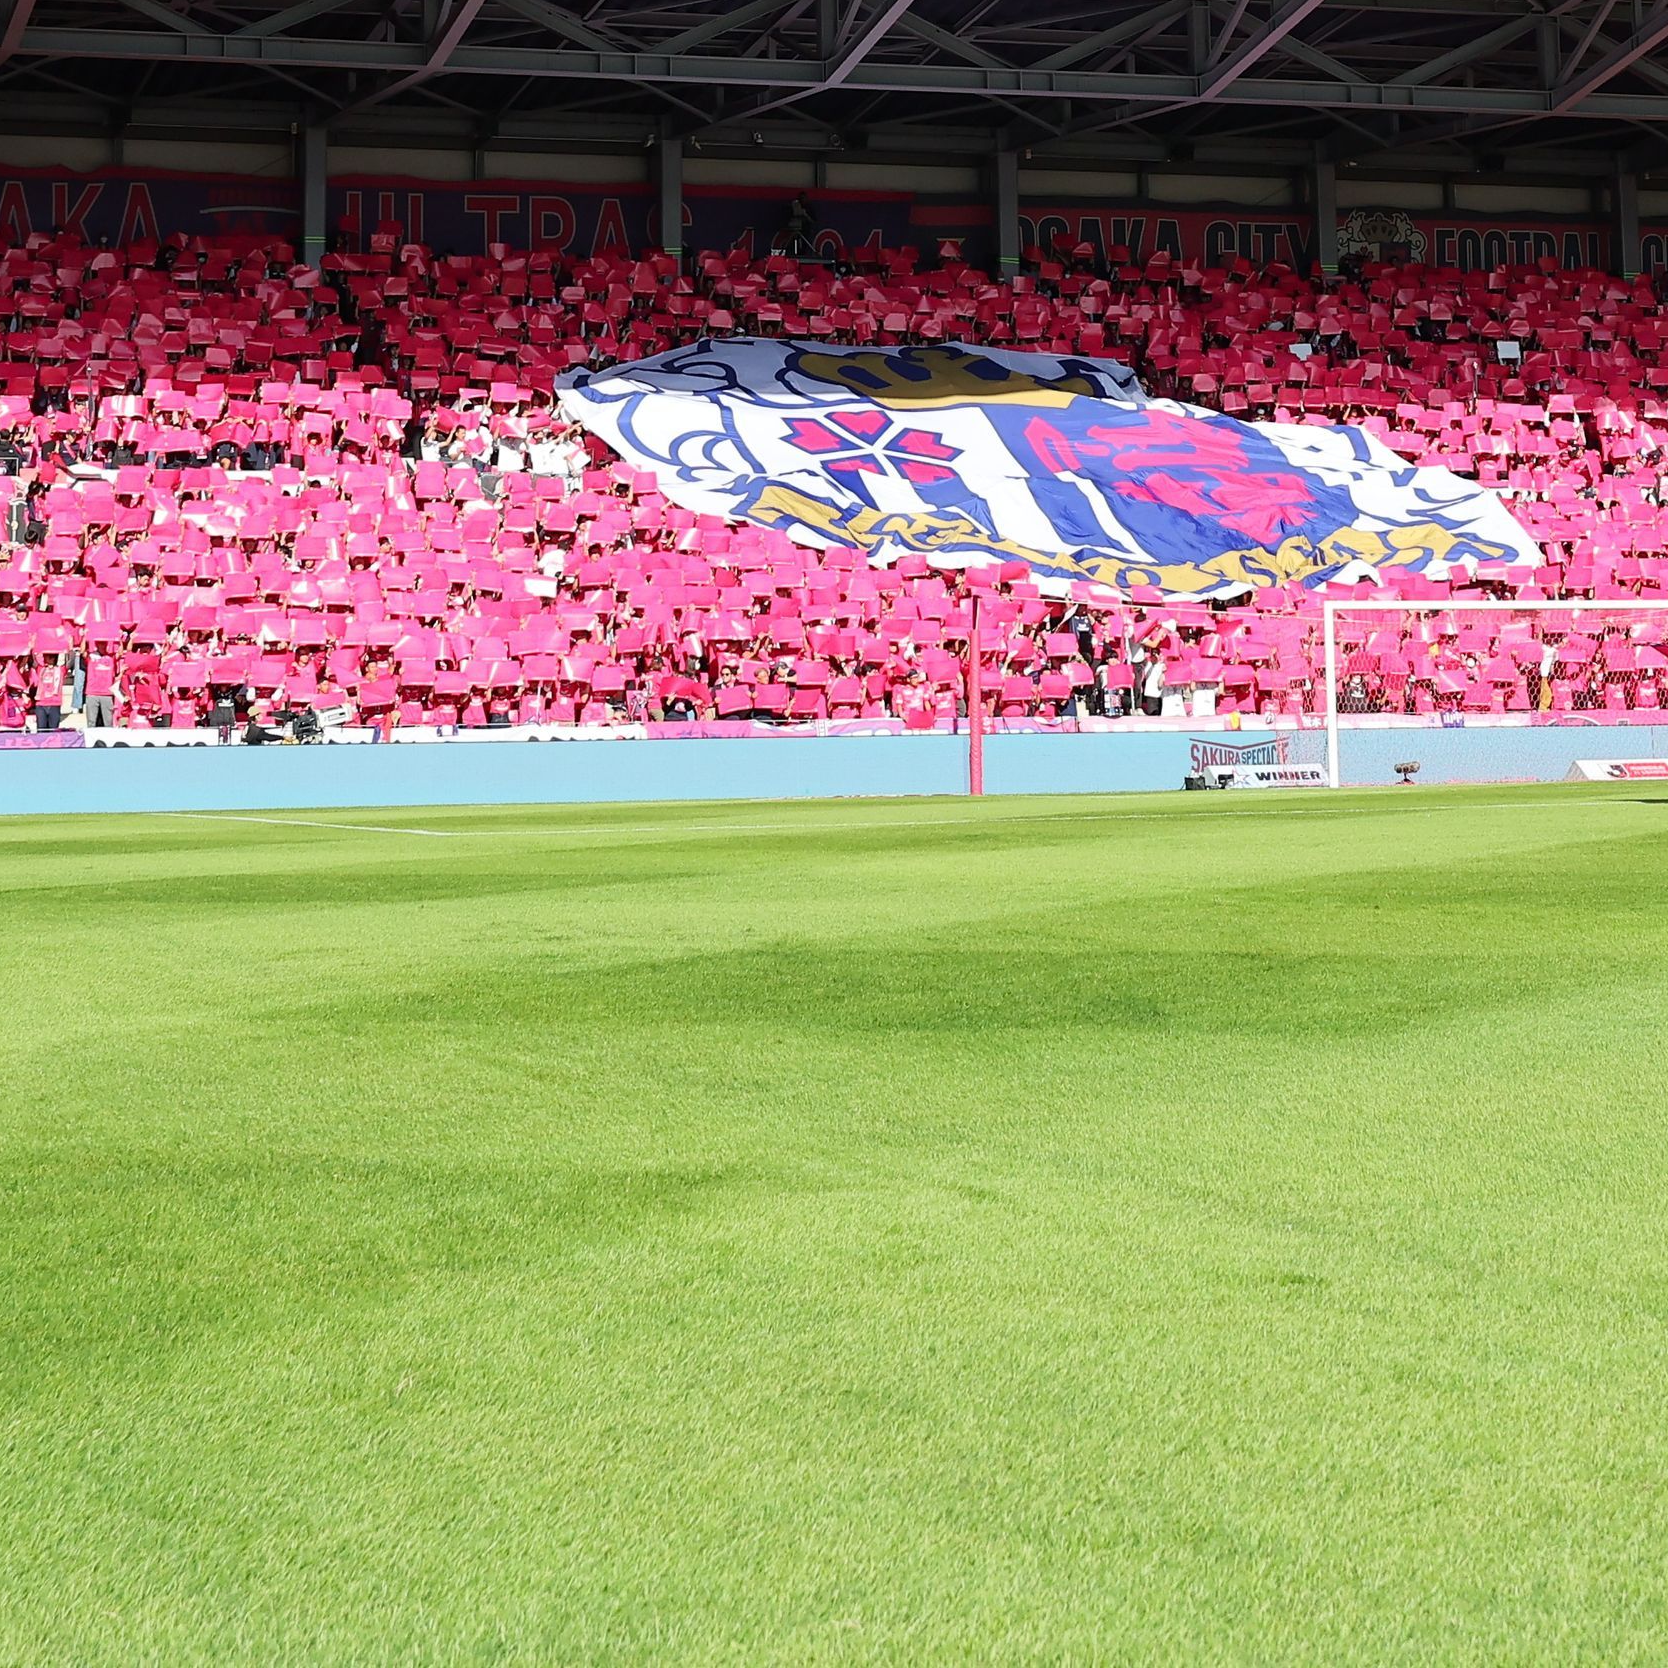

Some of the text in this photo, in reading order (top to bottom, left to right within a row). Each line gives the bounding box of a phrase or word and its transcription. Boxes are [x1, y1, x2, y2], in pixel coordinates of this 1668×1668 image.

[1434, 227, 1617, 274] FOOTBAL
[1190, 744, 1241, 774] SAKURA
[1255, 770, 1321, 782] WINNER
